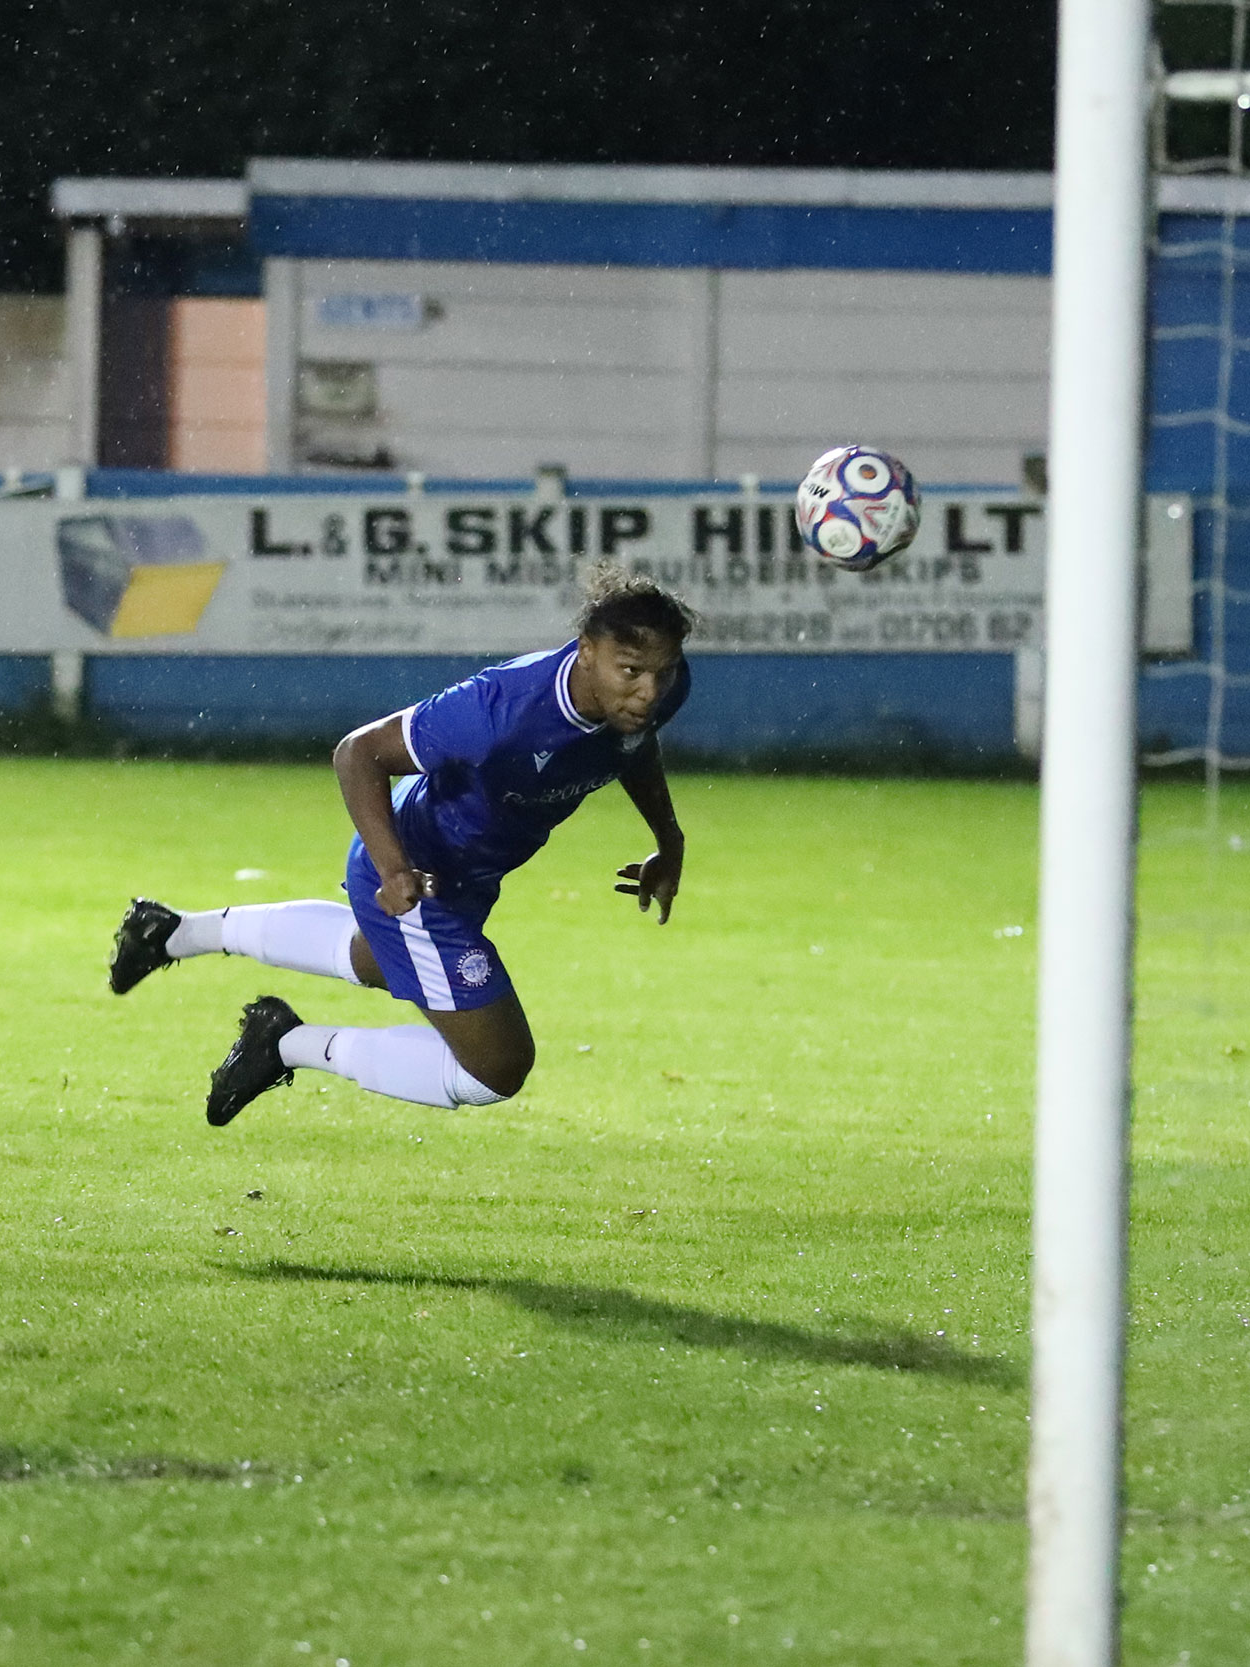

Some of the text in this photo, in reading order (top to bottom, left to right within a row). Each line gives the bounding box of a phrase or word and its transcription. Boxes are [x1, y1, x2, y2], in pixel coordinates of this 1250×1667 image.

[446, 506, 649, 555] SKIP
[692, 506, 805, 554] HI
[946, 504, 1042, 555] LT
